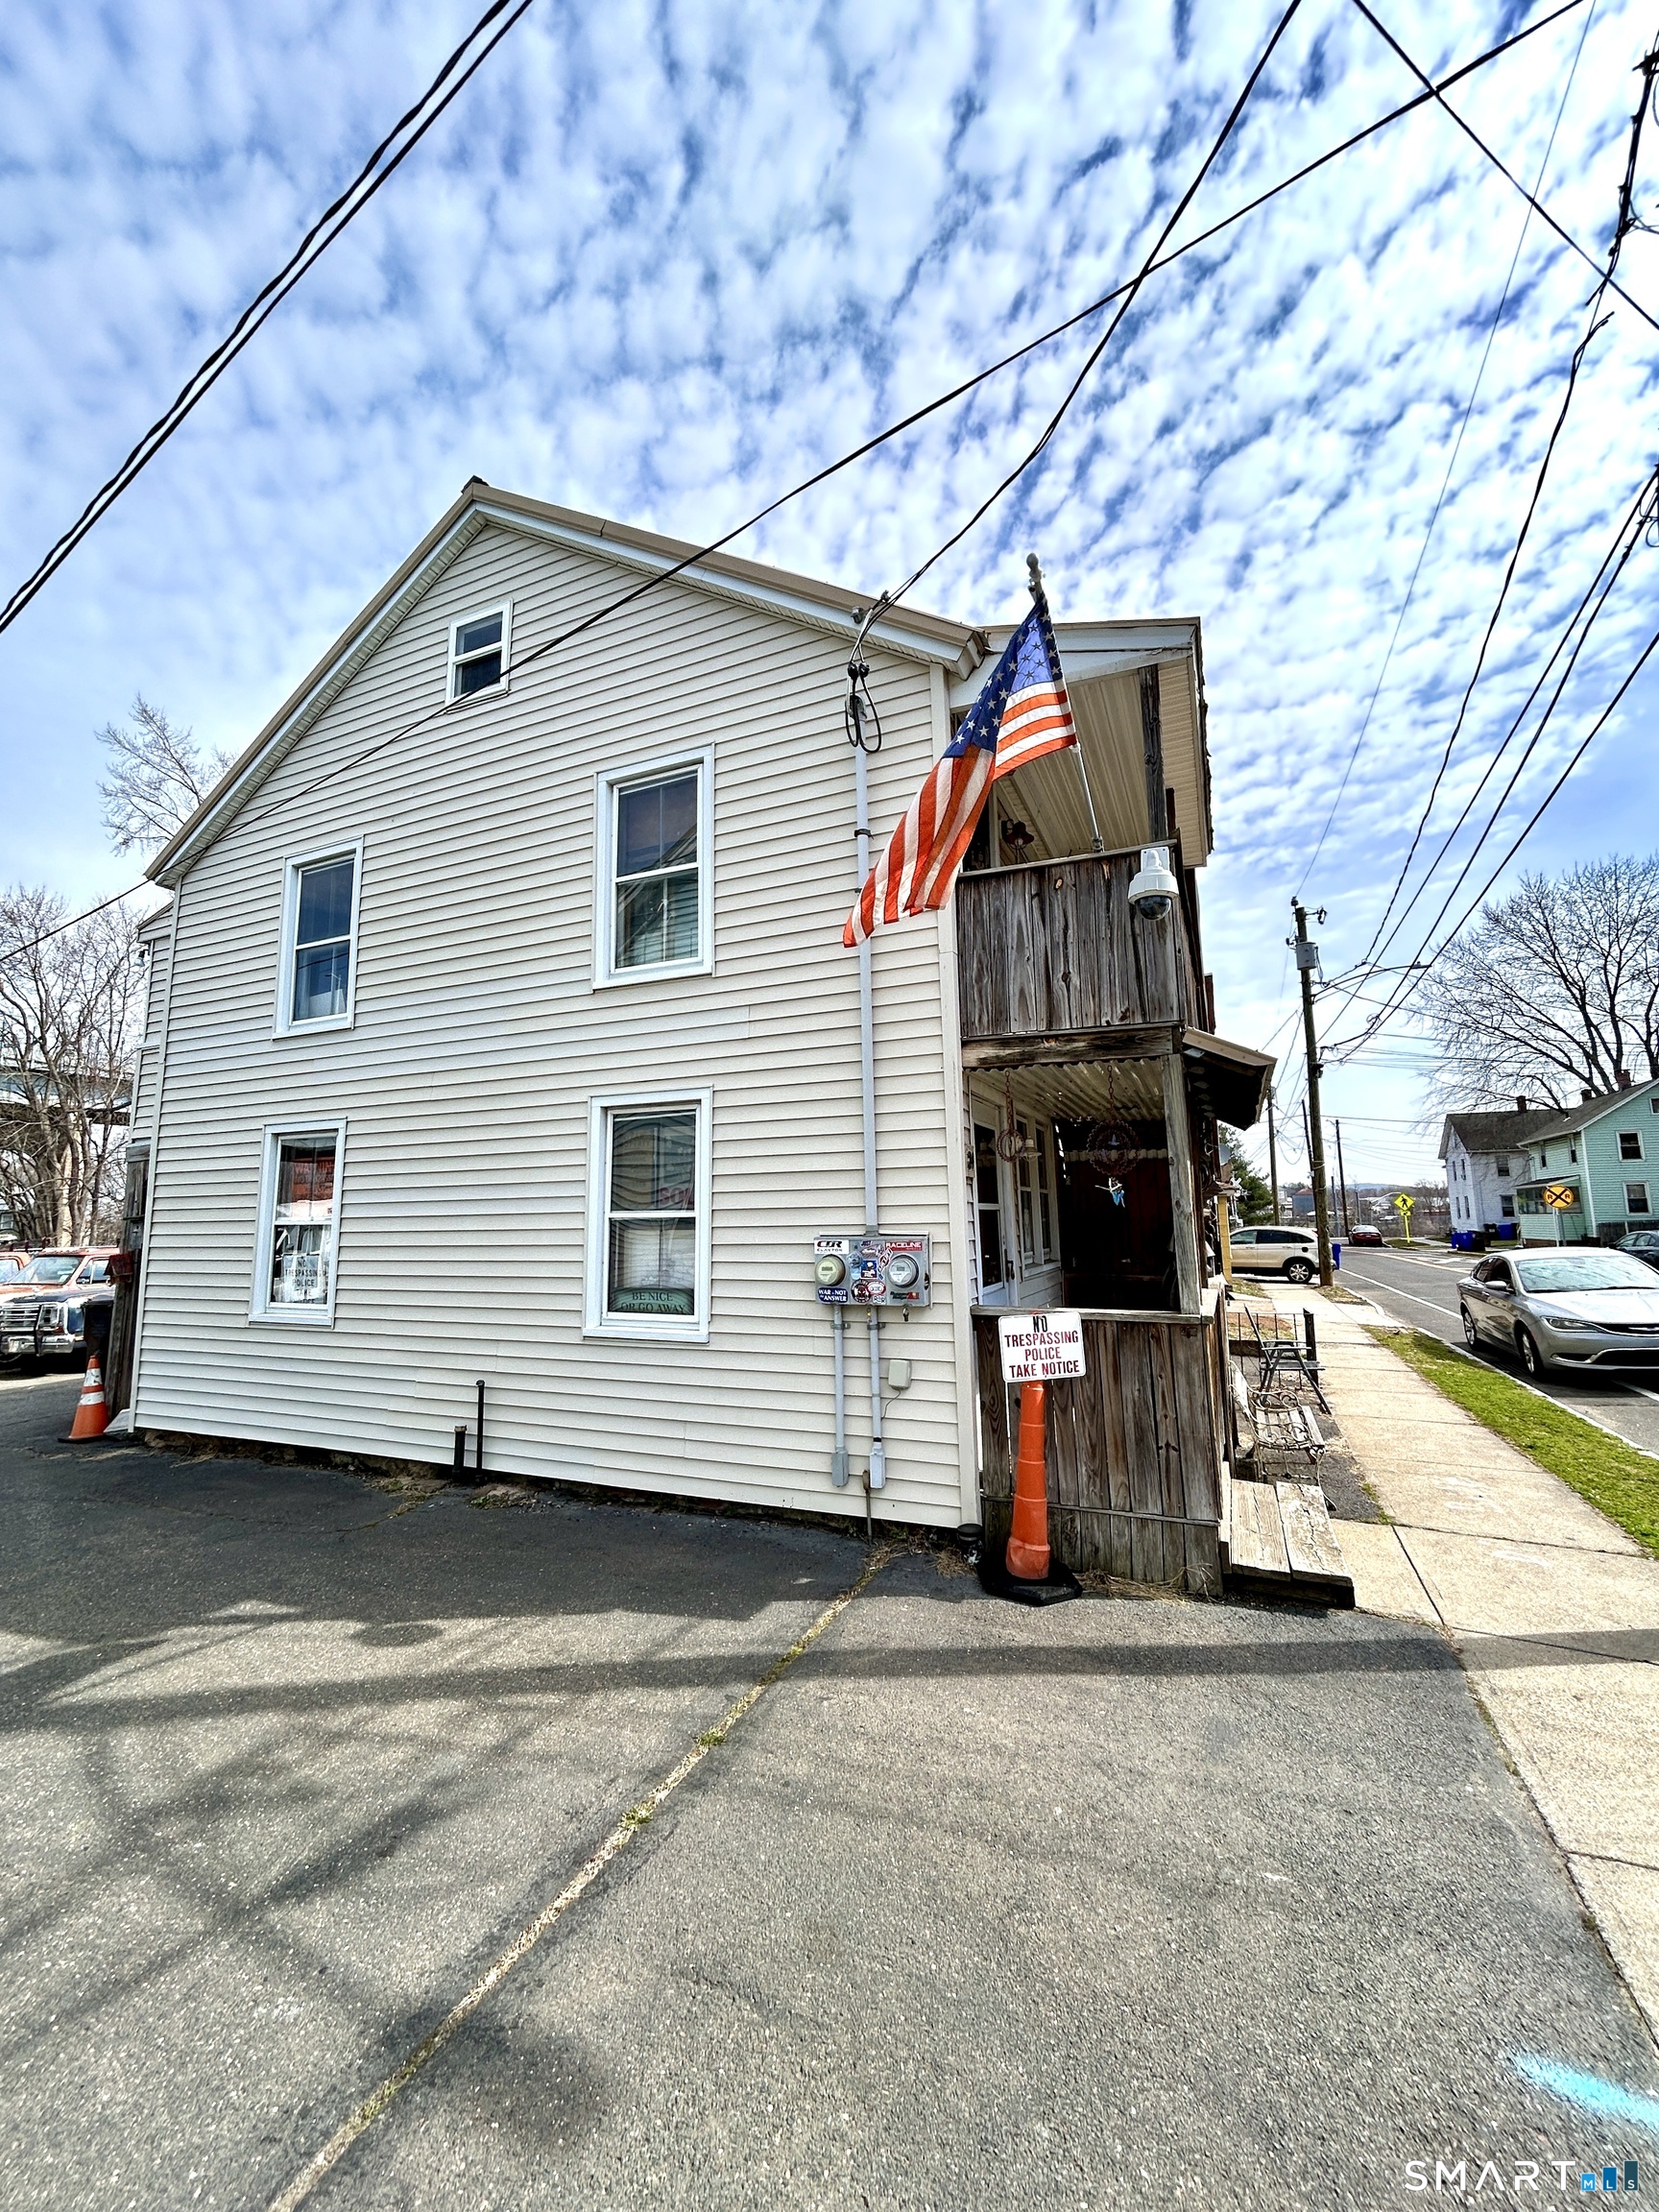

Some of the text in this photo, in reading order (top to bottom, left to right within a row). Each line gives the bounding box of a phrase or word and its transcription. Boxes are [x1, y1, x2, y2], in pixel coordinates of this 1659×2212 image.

[298, 1259, 307, 1267] NO
[632, 1291, 674, 1302] BE NICE
[621, 1302, 685, 1313] OR GO AWAY
[1032, 1314, 1048, 1334] NO
[1004, 1330, 1079, 1348] TRESPASSING
[1024, 1346, 1062, 1361] POLICE
[1009, 1359, 1080, 1379] TAKE NOTICE
